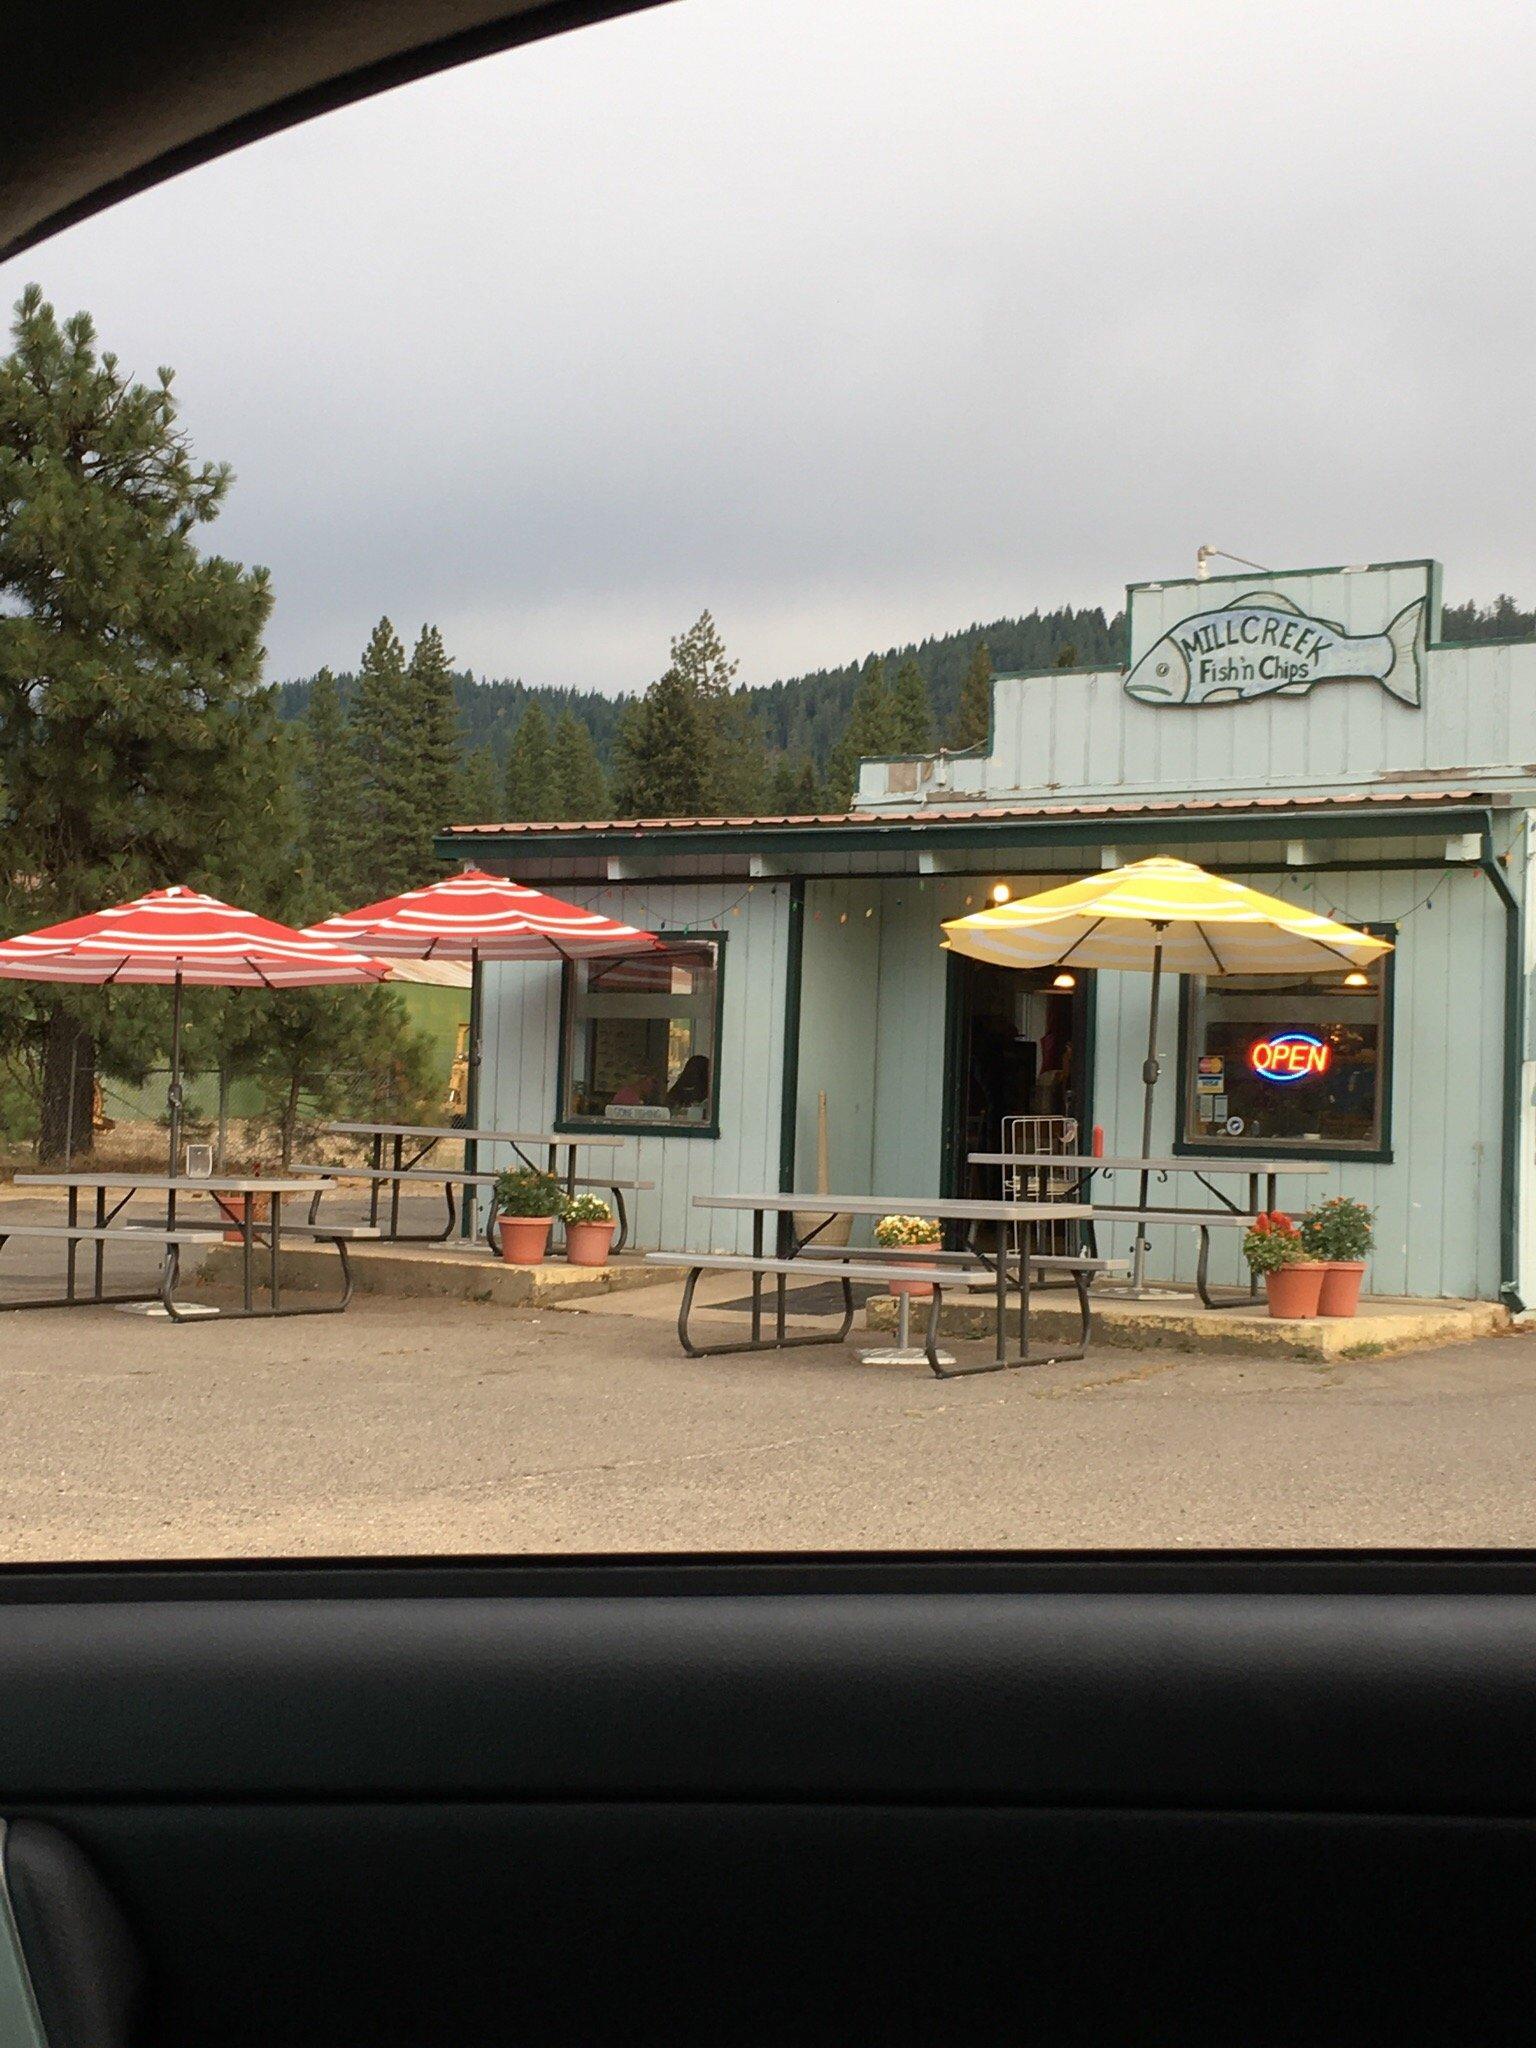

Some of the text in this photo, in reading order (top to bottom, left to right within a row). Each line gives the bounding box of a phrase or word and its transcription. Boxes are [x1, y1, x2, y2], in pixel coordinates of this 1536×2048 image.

[1180, 616, 1333, 666] MILLCREEK
[1259, 655, 1309, 683] Chips
[1253, 1043, 1328, 1072] OPEN
